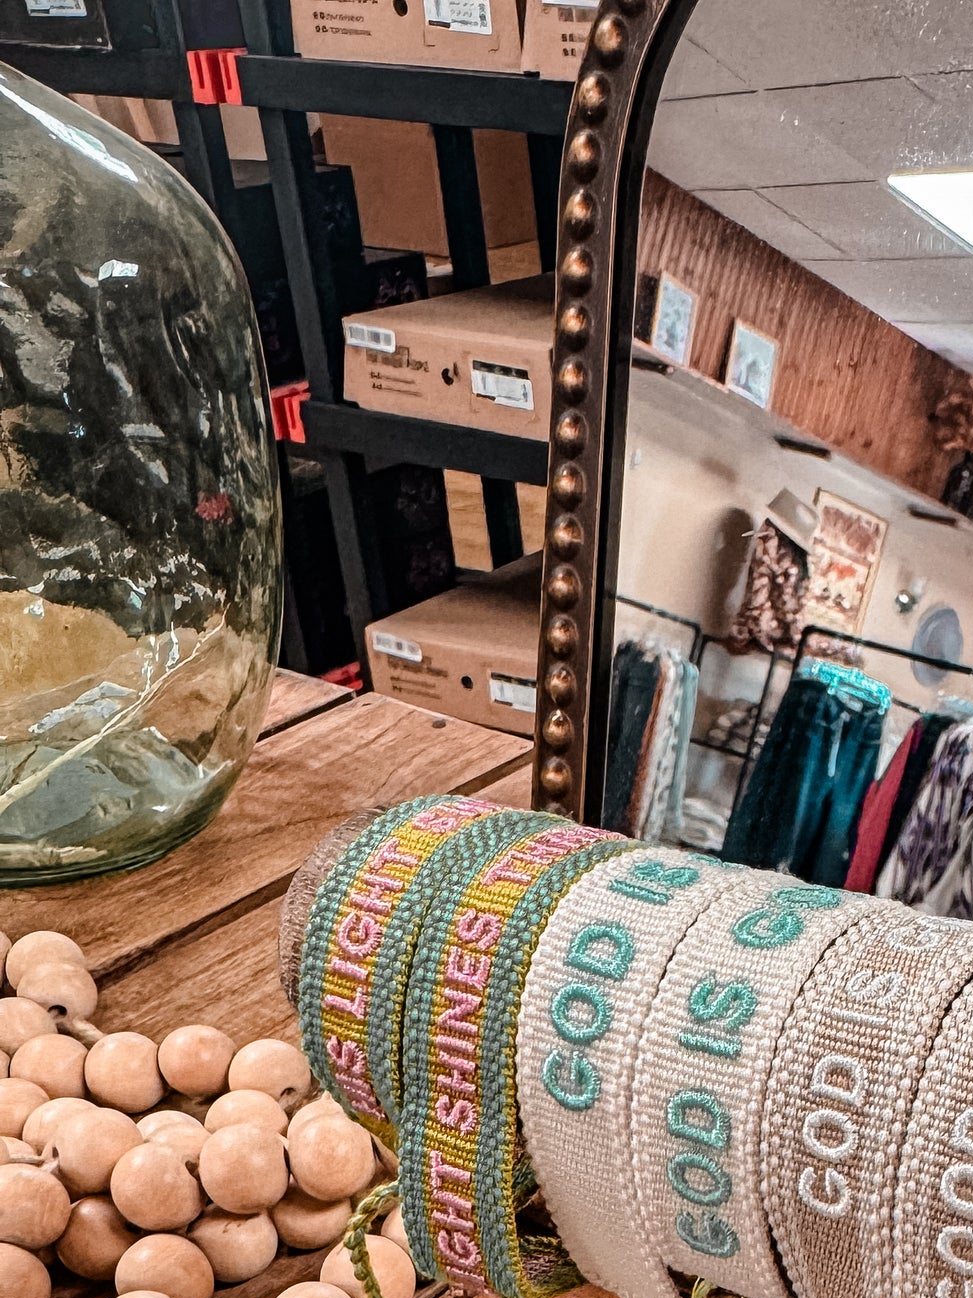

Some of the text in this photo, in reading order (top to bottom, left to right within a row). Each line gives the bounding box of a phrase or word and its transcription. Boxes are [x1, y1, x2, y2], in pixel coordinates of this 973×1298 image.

[324, 838, 422, 1021] LIGHT
[434, 908, 505, 1135] SHINES
[541, 919, 636, 1112] GOD
[677, 970, 758, 1060] IS
[666, 1088, 742, 1260] GOD
[799, 968, 902, 1219] GOD IS
